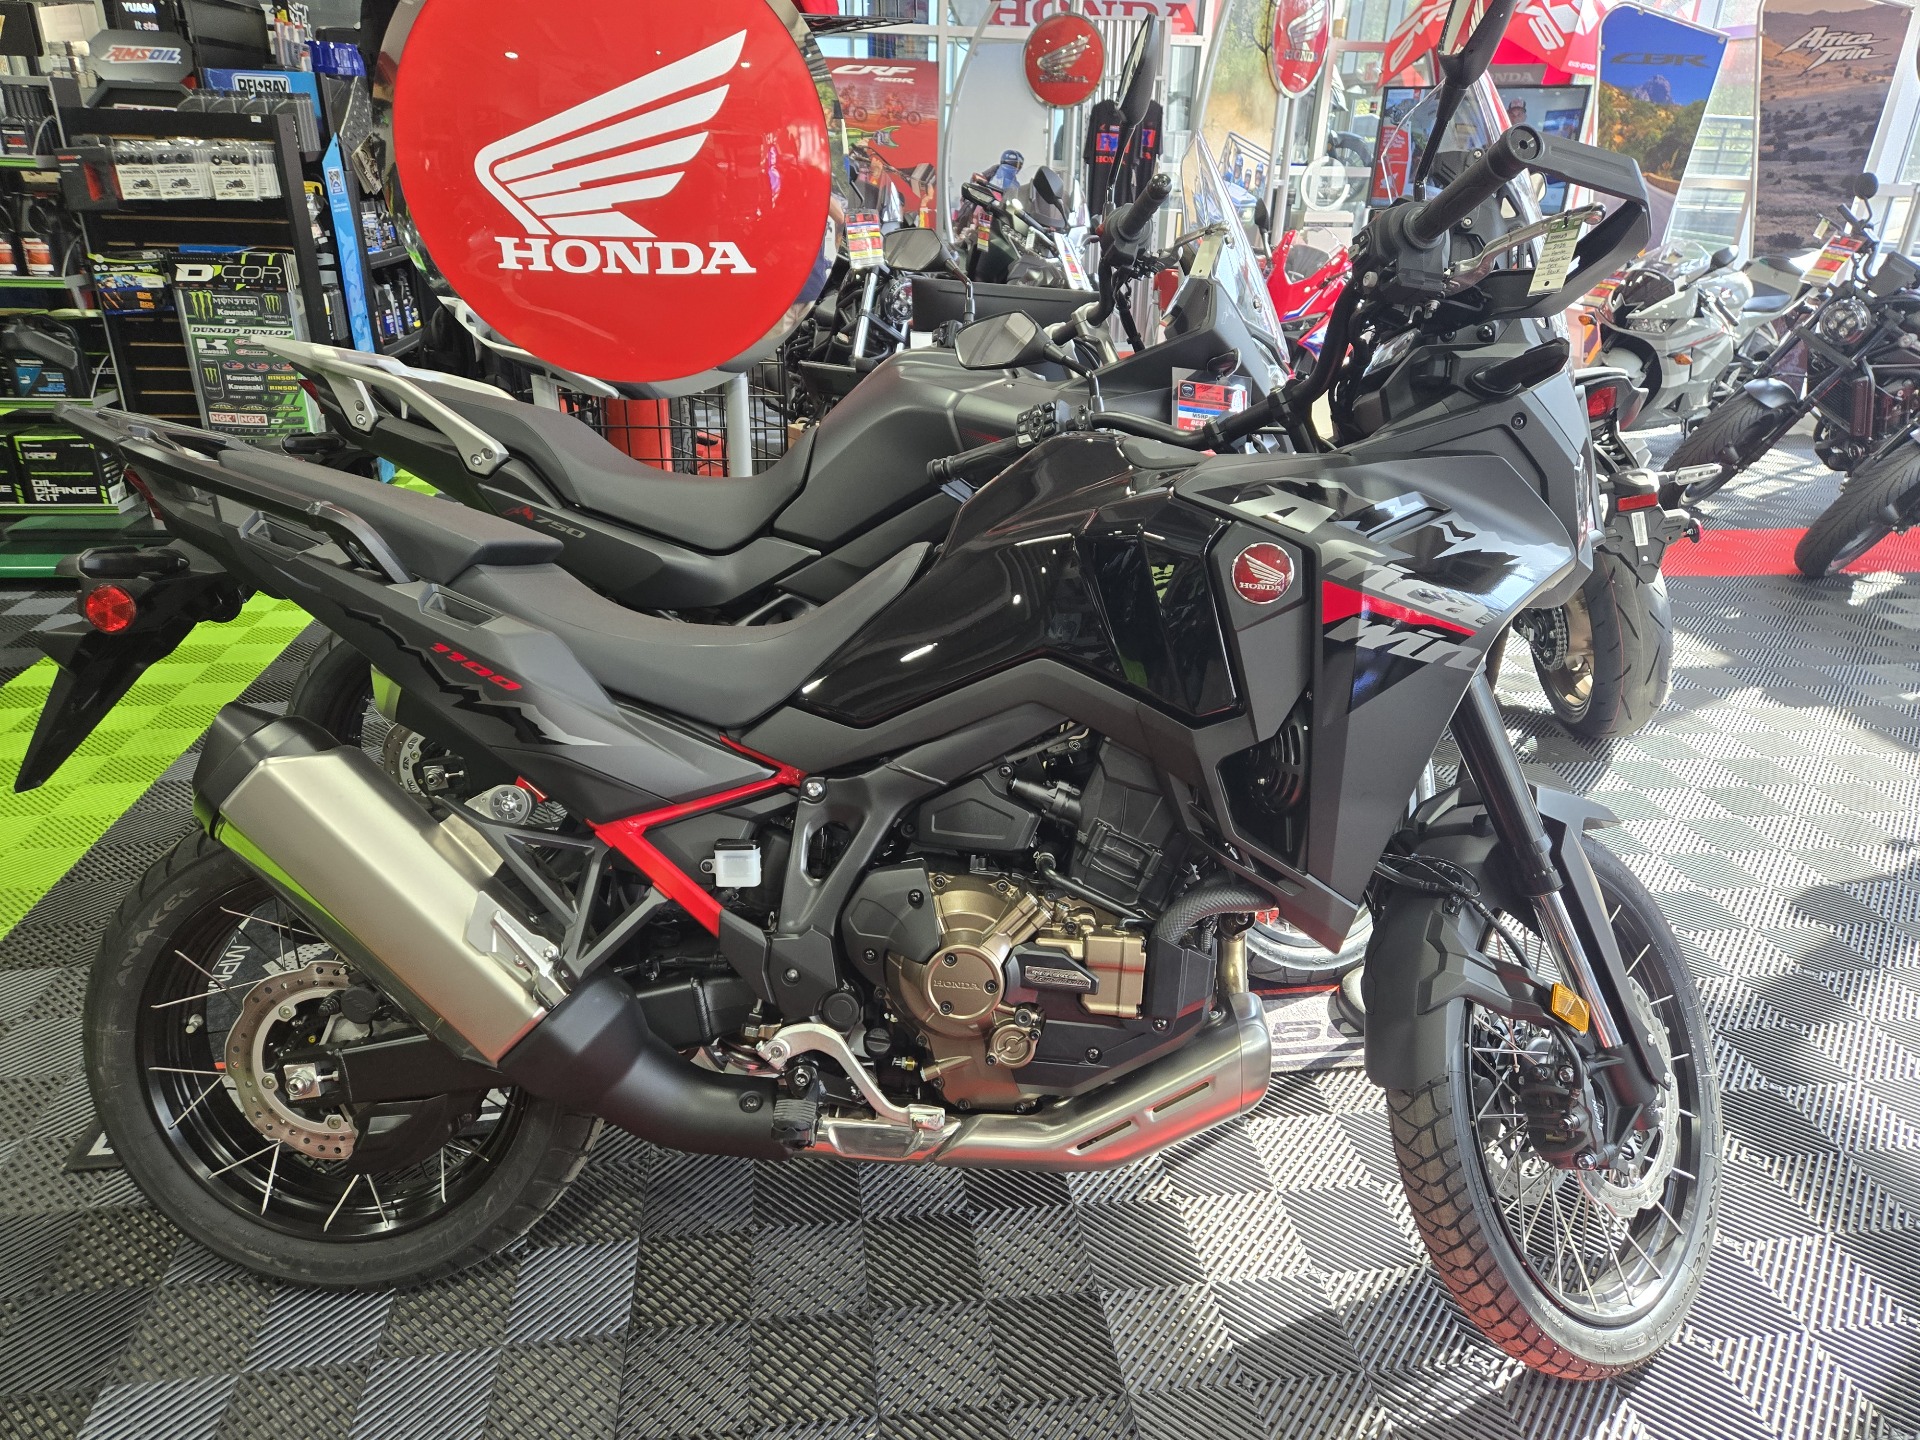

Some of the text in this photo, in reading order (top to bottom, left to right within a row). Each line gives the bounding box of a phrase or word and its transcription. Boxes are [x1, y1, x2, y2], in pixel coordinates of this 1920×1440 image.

[121, 2, 157, 14] YUASA
[1779, 25, 1888, 55] Africa
[105, 46, 181, 62] AMSOIL
[1610, 52, 1711, 68] CBR
[1800, 46, 1890, 76] Twin
[831, 64, 917, 76] CRF
[494, 235, 757, 275] HONDA
[212, 297, 258, 306] MONSTER
[217, 308, 257, 317] Kawasaki
[192, 326, 292, 337] DUNLOP DUNLOP
[225, 374, 262, 382] Kawasaki
[227, 383, 264, 391] Kawasaki
[211, 414, 233, 422] NGK
[240, 415, 263, 424] NGK
[31, 479, 58, 487] OIL
[33, 486, 98, 495] CHANGE
[35, 494, 60, 502] KIT
[534, 515, 587, 539] 750
[1239, 581, 1284, 593] HONDA
[430, 643, 523, 691] 1100
[933, 979, 981, 991] HONDA
